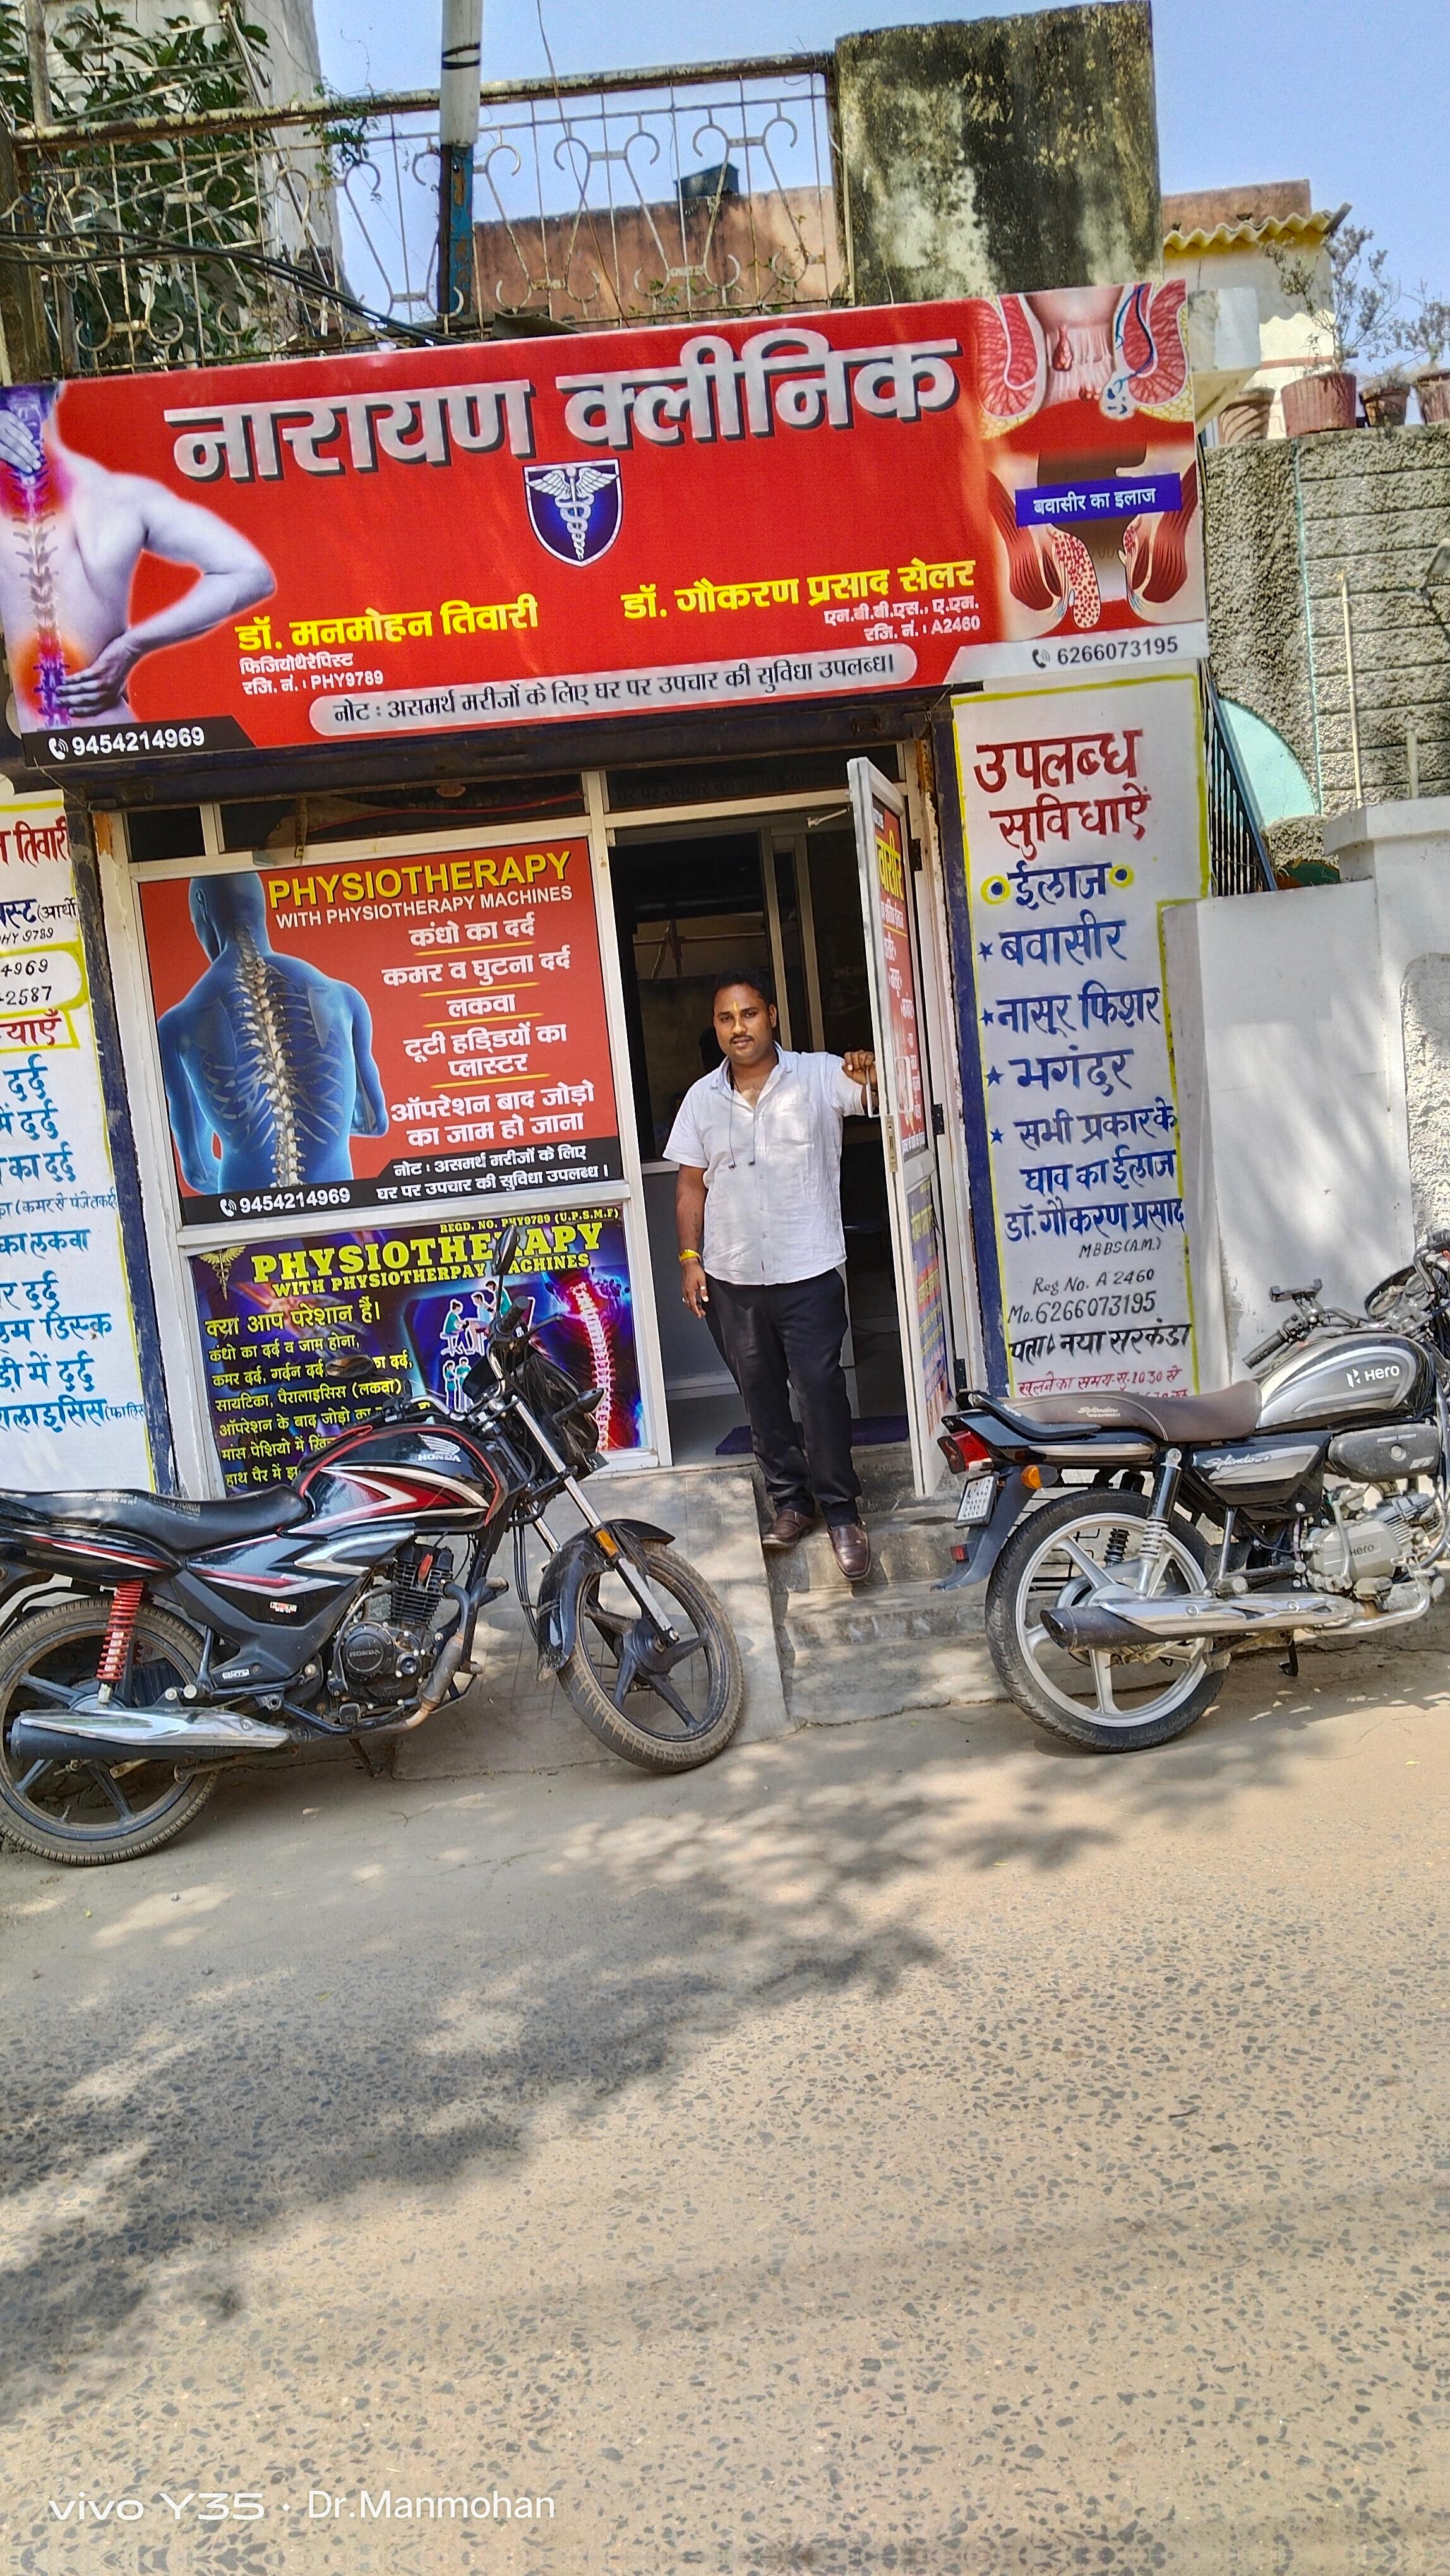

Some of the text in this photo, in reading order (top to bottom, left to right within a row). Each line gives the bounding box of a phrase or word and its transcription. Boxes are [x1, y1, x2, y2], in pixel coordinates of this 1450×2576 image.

[164, 328, 963, 484] नारायण क्लीनिक
[1033, 487, 1156, 515] बवासीर का इलाज
[621, 558, 976, 619] डॉ. गौकरण प्रसाद सेलर
[235, 593, 539, 651] डॉ. मनमोहन तिवारी
[864, 623, 898, 641] रजि.
[931, 615, 981, 635] A2460
[1057, 636, 1178, 665] 6266073195
[242, 677, 277, 695] रजि.
[311, 669, 384, 690] PHY9789
[333, 700, 370, 723] नोट
[387, 689, 455, 719] असमर्थ
[462, 683, 520, 712] मरीजों
[526, 682, 546, 706] के
[551, 679, 589, 707] लिए
[595, 680, 620, 700] घर
[626, 677, 652, 696] पर
[658, 672, 719, 693] उपचार
[724, 662, 750, 688] की
[757, 659, 813, 694] सुविधा
[72, 726, 205, 756] 9454214969
[974, 729, 1143, 793] उपलब्ध
[268, 850, 572, 909] PHYSIOTHERAPY
[1007, 860, 1113, 910] ईलाज
[275, 885, 573, 929] WITH PHYSIOTHERAPY MACHINES
[0, 927, 54, 945] HY 9789
[409, 911, 535, 946] कंधो का दर्द
[998, 909, 1127, 967] बवासीर
[381, 944, 571, 986] कमर व घुटना दर्द
[0, 985, 52, 1006] 2587
[446, 993, 516, 1018] लकवा
[996, 994, 1077, 1038] नासूर
[403, 1030, 446, 1063] टूटी
[536, 1023, 567, 1043] का
[3, 1054, 49, 1102] दर्द
[448, 1053, 528, 1078] प्लास्टर
[1009, 1044, 1134, 1096] भगंदर
[390, 1079, 595, 1123] ऑपरेशन बाद जोड़ो
[17, 1098, 59, 1140] दर्द
[406, 1112, 584, 1147] का जाम हो जाना
[1013, 1097, 1178, 1151] सभी प्रकार के
[8, 1154, 41, 1184] का
[42, 1141, 76, 1182] दर्द
[393, 1143, 587, 1178] नोट असमर्थ मरीजों के लिए
[1019, 1144, 1177, 1196] घाव का ईलाज
[239, 1187, 351, 1213] 9454214969
[376, 1186, 398, 1200] घर
[401, 1184, 421, 1198] पर
[425, 1178, 472, 1195] उपचार
[476, 1173, 496, 1191] की
[499, 1169, 543, 1191] सुविधा
[440, 1223, 475, 1234] REGD.
[479, 1220, 498, 1230] NO.
[554, 1207, 619, 1225] (U.P.S.M.F)
[1036, 1196, 1130, 1238] गौकरण
[1132, 1198, 1185, 1234] प्रसाद
[30, 1229, 91, 1260] लकवा
[273, 1253, 590, 1298] WITH PHYSIOTHERPAY ACHINES
[1113, 1268, 1154, 1285] 2460
[39, 1311, 112, 1341] डिस्क
[205, 1317, 239, 1337] क्या
[248, 1313, 284, 1333] आप
[291, 1303, 353, 1328] परेशान
[209, 1344, 237, 1363] कंधो
[241, 1345, 257, 1359] का
[261, 1338, 280, 1359] दर्द
[284, 1342, 294, 1355] व
[298, 1337, 323, 1352] जाम
[1060, 1330, 1107, 1357] नया
[26, 1351, 51, 1389] में
[212, 1372, 239, 1388] कमर
[270, 1362, 301, 1382] गर्दन
[277, 1384, 347, 1405] पैरालाइसिस
[219, 1418, 273, 1438] ऑपरेशन
[277, 1413, 289, 1429] के
[293, 1412, 317, 1429] बाद
[222, 1443, 246, 1462] मांस
[295, 1434, 305, 1452] में
[417, 1453, 461, 1462] HONDA
[225, 1471, 248, 1488] हाथ
[253, 1467, 268, 1483] पैर
[349, 1649, 381, 1657] HONDA
